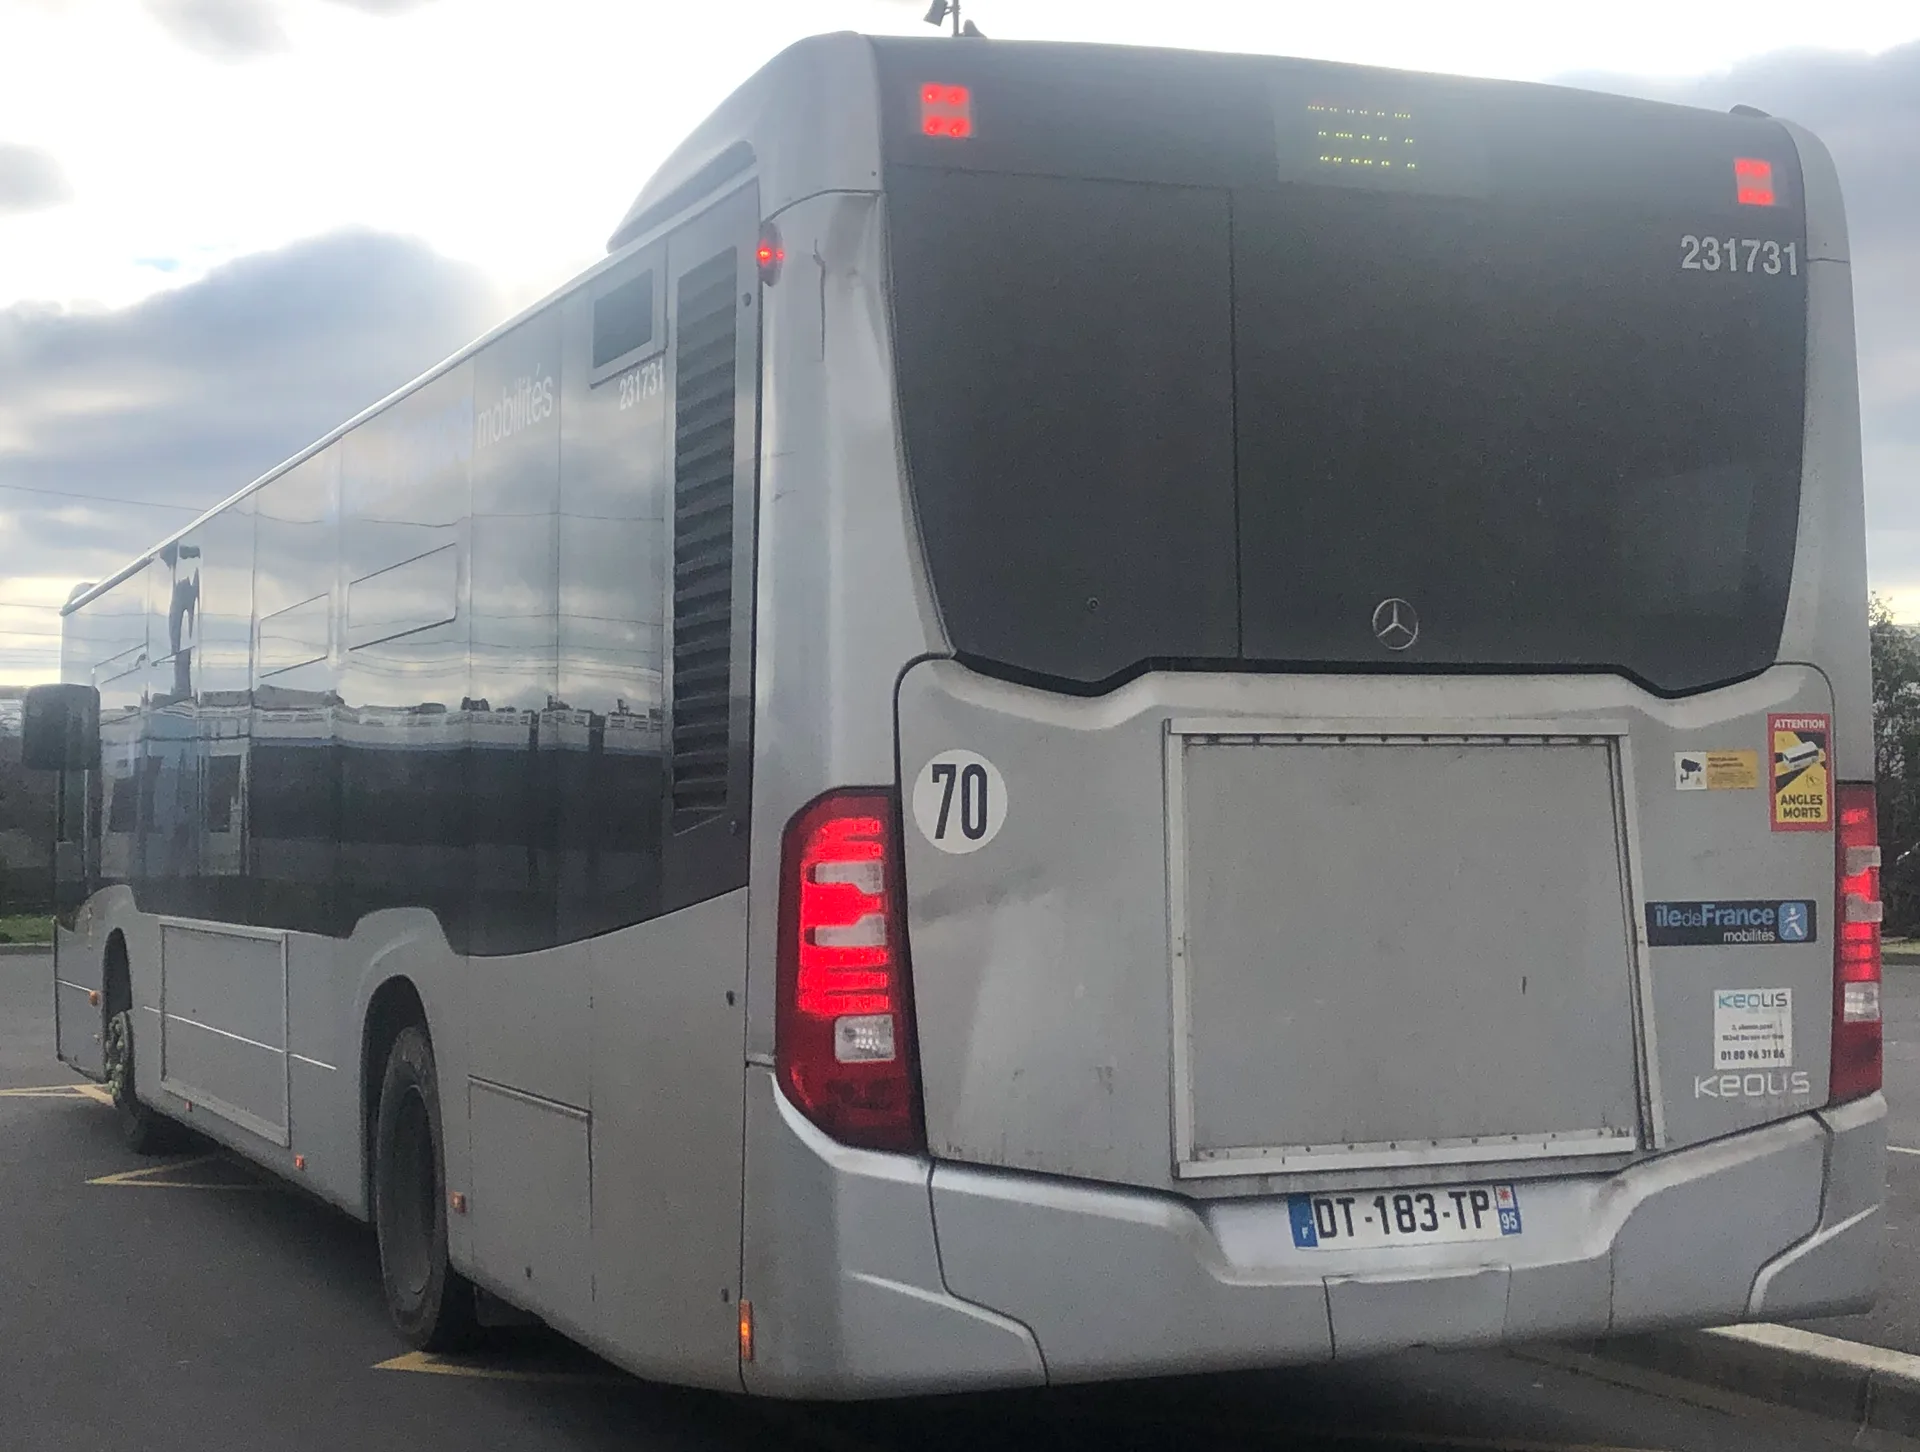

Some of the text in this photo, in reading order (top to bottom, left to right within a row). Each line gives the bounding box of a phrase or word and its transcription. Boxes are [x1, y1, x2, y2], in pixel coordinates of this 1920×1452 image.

[1680, 234, 1798, 276] 231731
[618, 358, 665, 411] 231731
[476, 362, 554, 450] mobilités
[1774, 718, 1826, 730] ATTENTION
[931, 763, 988, 841] 70
[1780, 794, 1823, 806] ANGLES
[1783, 807, 1821, 819] MORTS
[1723, 927, 1776, 943] mobilités
[1500, 1211, 1519, 1231] 95
[1301, 1226, 1310, 1240] F
